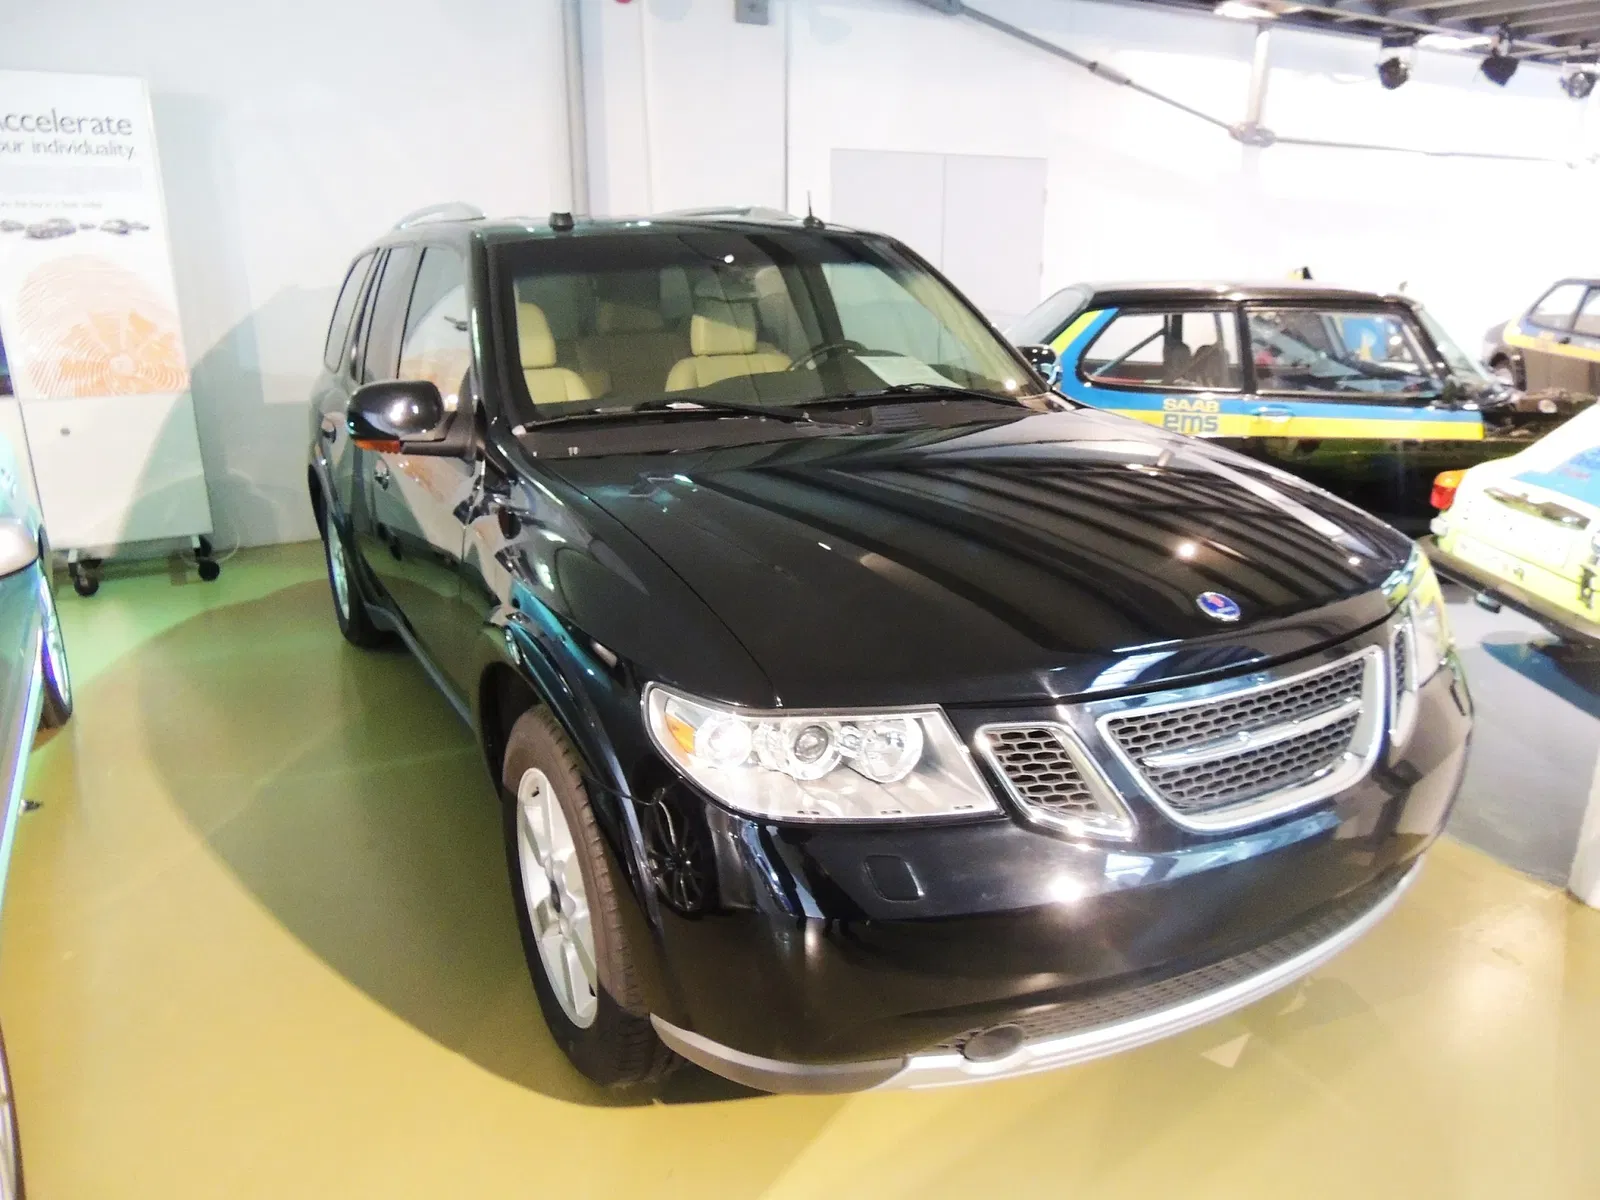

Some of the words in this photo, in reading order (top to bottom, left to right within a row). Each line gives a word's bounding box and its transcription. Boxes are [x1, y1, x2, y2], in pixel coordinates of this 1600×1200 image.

[31, 136, 135, 162] individuality
[1163, 398, 1219, 413] SAAB
[1163, 413, 1218, 433] ems
